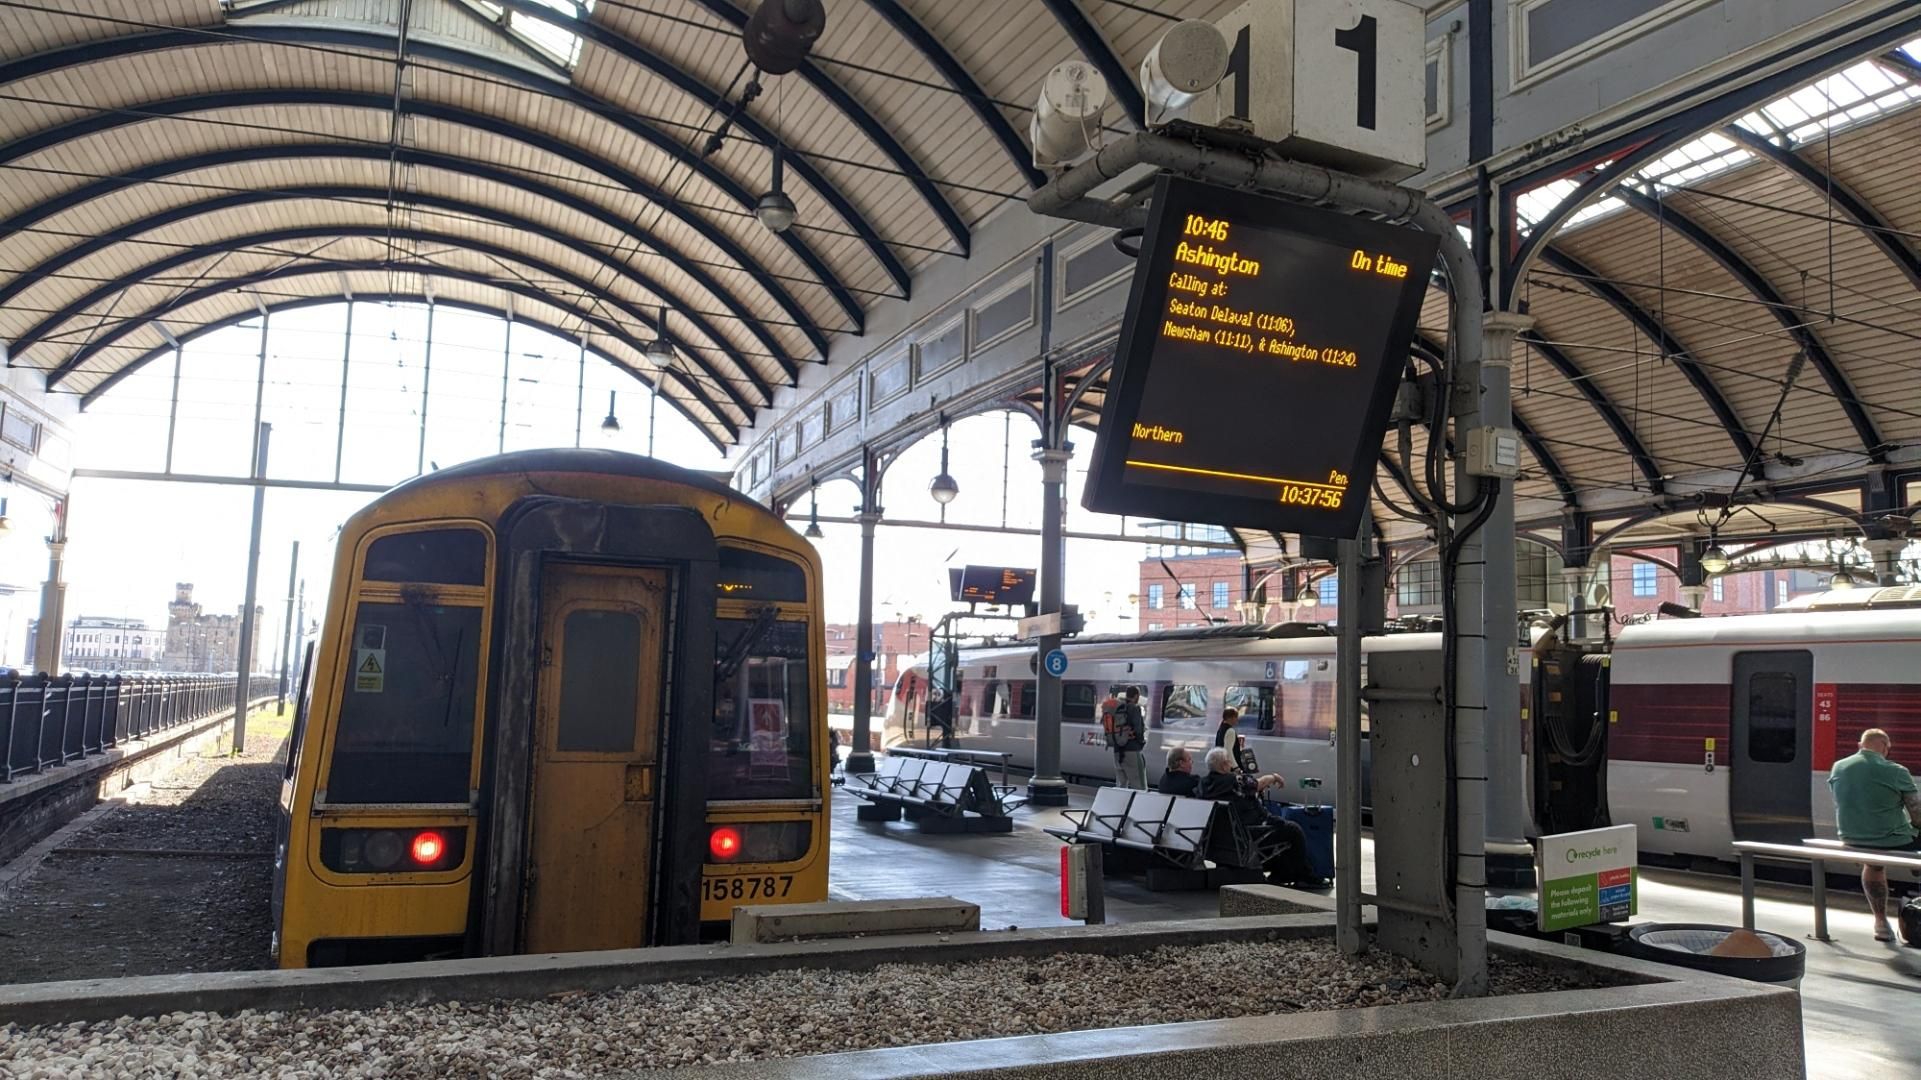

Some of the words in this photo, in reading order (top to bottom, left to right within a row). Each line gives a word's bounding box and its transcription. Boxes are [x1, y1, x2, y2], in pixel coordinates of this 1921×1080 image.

[1335, 14, 1377, 131] 1
[1183, 214, 1230, 241] 10:46
[1175, 241, 1260, 276] Ashington
[1351, 249, 1372, 271] On
[1375, 254, 1408, 278] time
[1168, 271, 1208, 297] Calling
[1210, 281, 1228, 297] at:
[1169, 298, 1208, 319] Seaton
[1210, 305, 1254, 327] Delaval
[1256, 313, 1296, 338] (11:06),
[1163, 320, 1211, 343] Newsham
[1214, 329, 1254, 353] (11:11),
[1258, 336, 1267, 352] &
[1268, 338, 1319, 361] Ashington
[1321, 347, 1357, 367] (11:24).
[1131, 422, 1183, 444] Northern
[1280, 485, 1343, 509] 10:37:56
[1052, 657, 1062, 671] 8
[1819, 700, 1831, 708] 43
[1578, 847, 1601, 859] recycle
[1603, 846, 1617, 855] here
[702, 876, 793, 901] 158787
